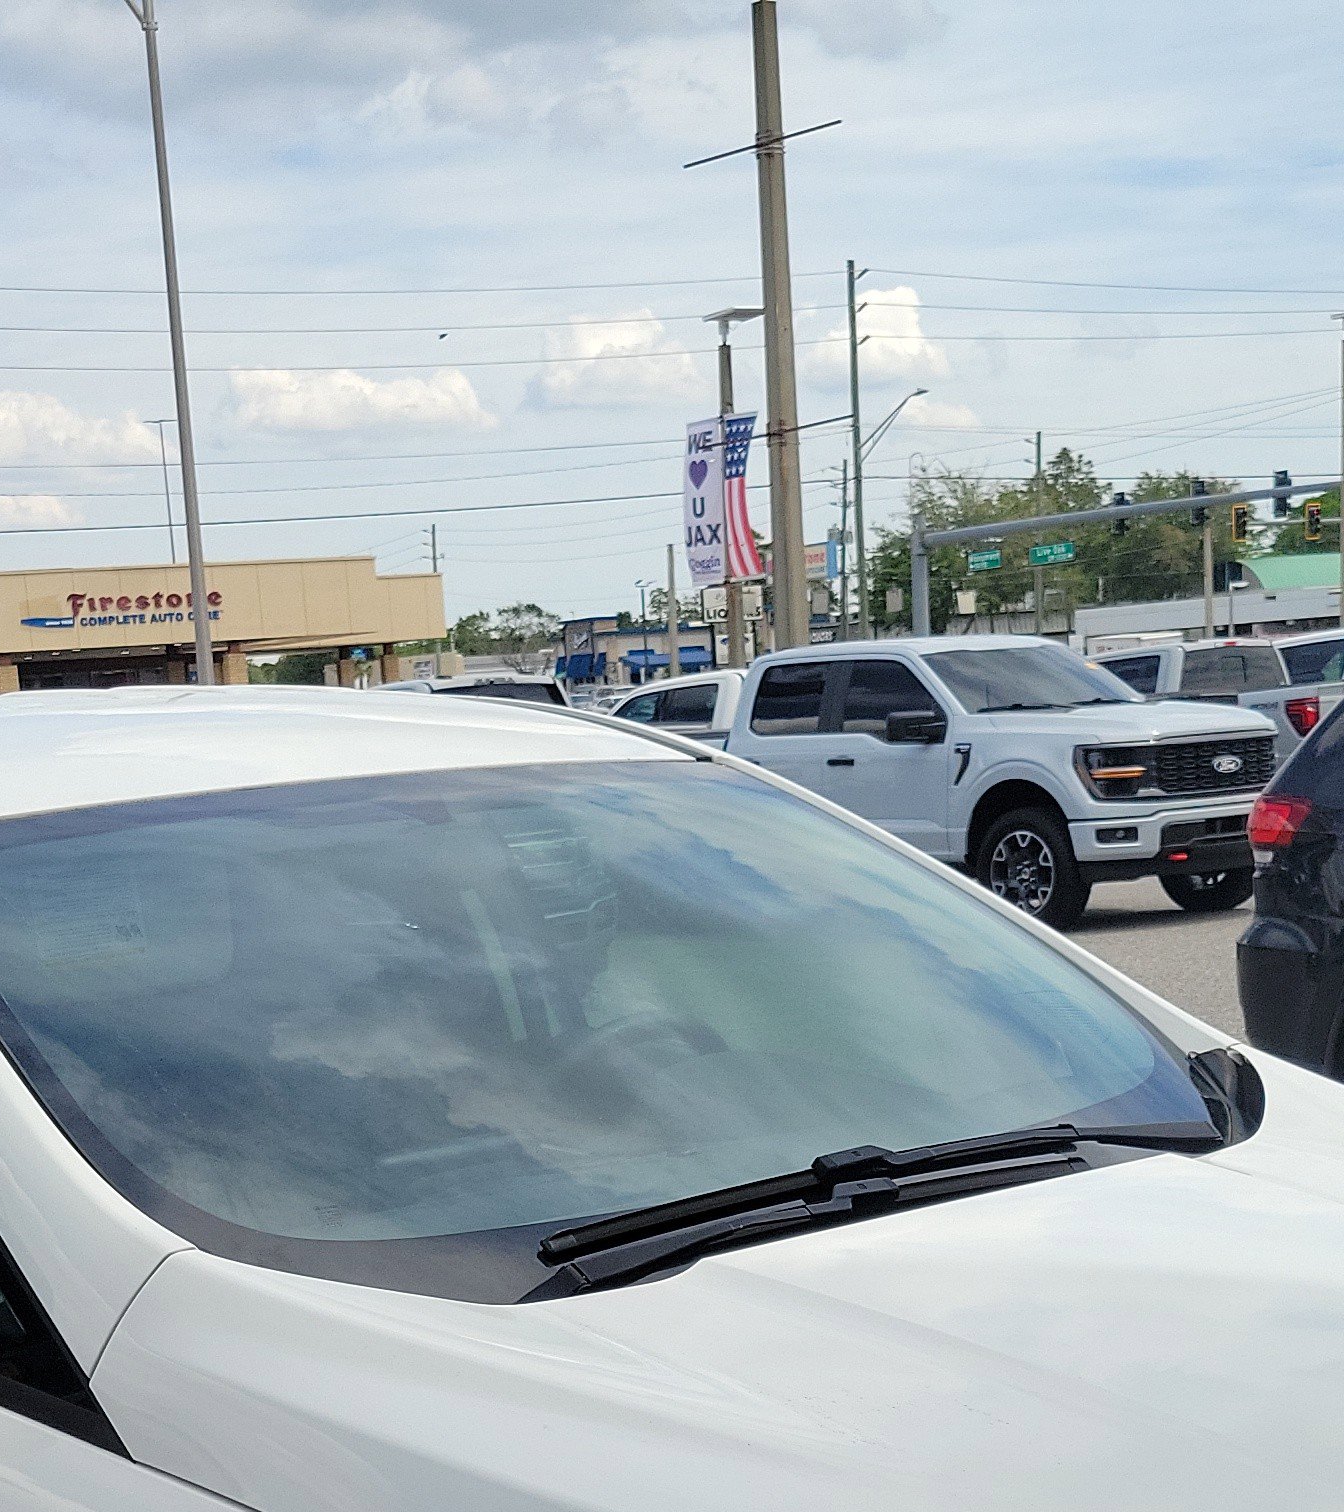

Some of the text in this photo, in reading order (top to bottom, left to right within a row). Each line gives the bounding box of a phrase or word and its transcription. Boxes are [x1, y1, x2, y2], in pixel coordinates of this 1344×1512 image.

[688, 431, 713, 454] WE
[692, 497, 705, 518] U
[685, 524, 721, 547] JAX
[689, 555, 720, 573] Coggin
[80, 614, 146, 627] COMPLETE
[150, 612, 184, 624] AUTO
